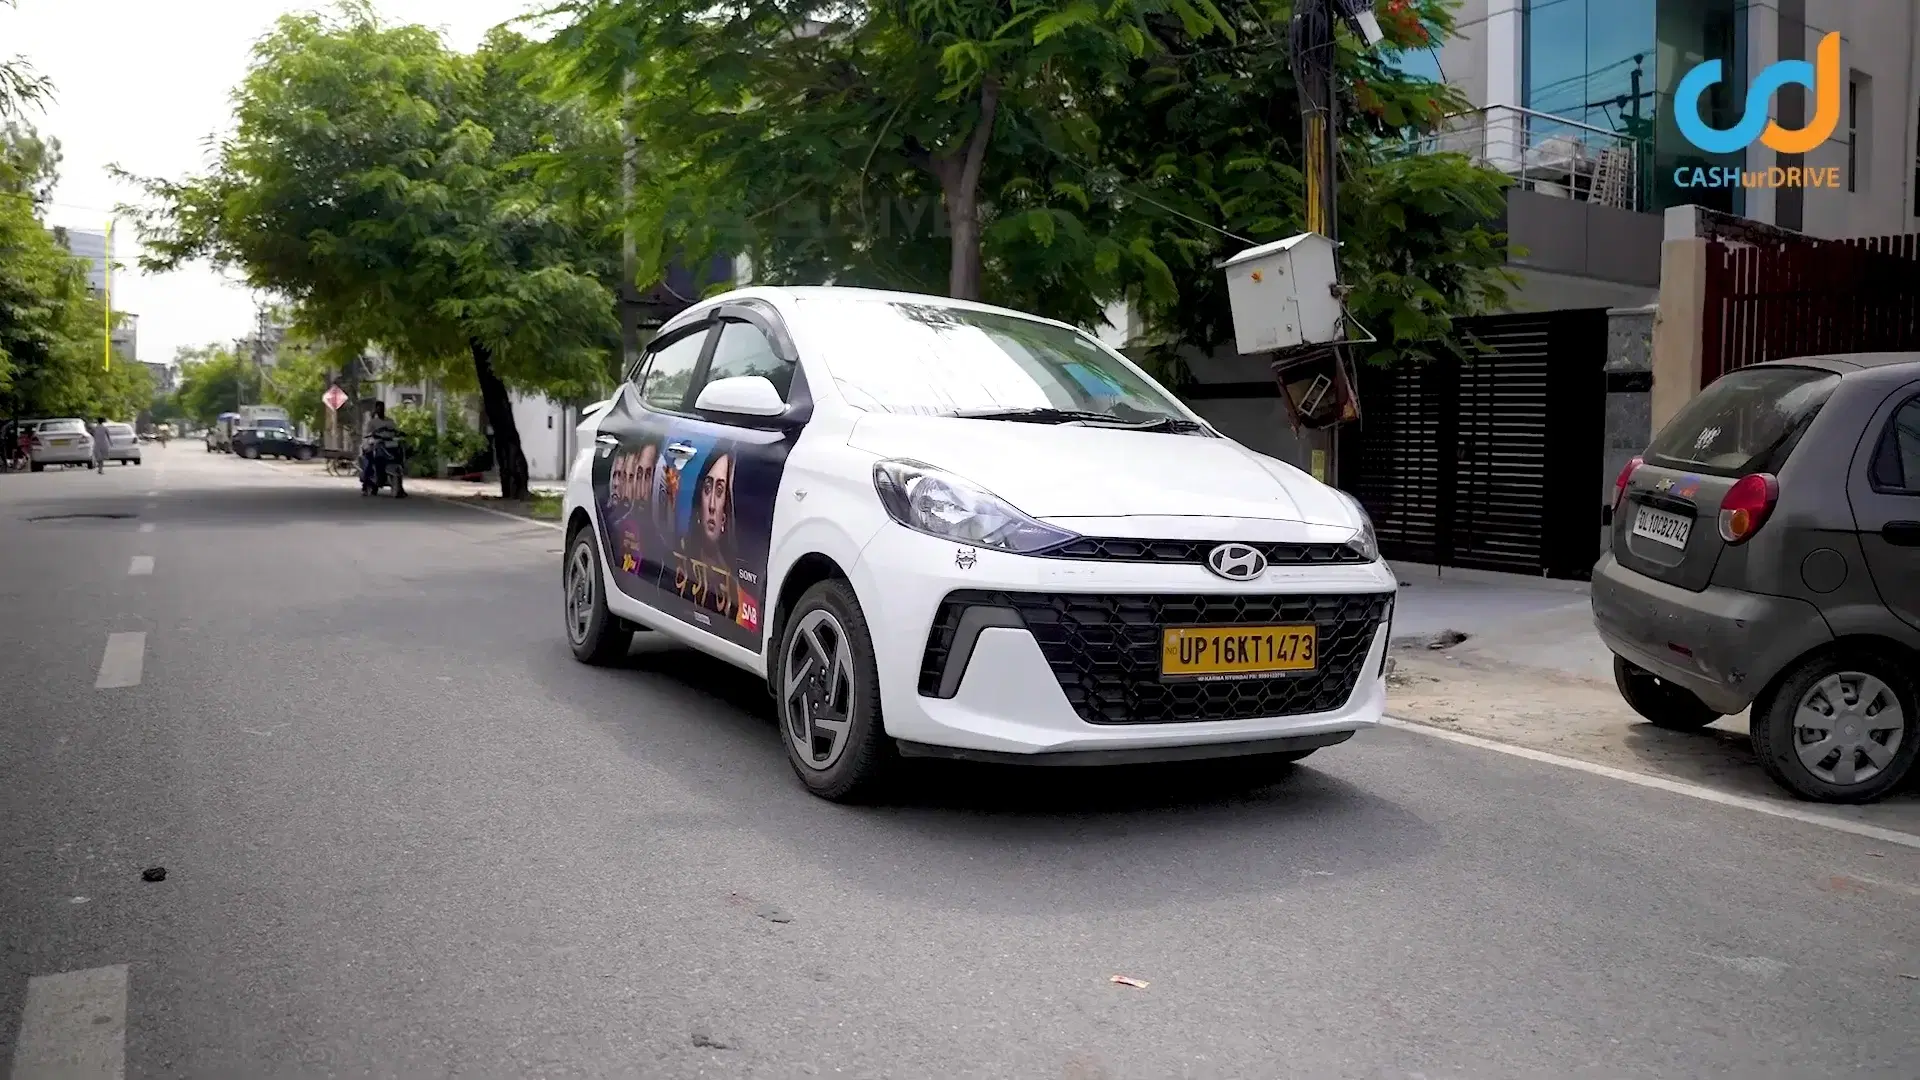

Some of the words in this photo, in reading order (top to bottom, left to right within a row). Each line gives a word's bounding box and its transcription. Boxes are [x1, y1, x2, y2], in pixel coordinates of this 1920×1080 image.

[738, 568, 758, 585] SONY
[742, 602, 757, 625] SAB
[1179, 633, 1314, 665] UP16KT1473
